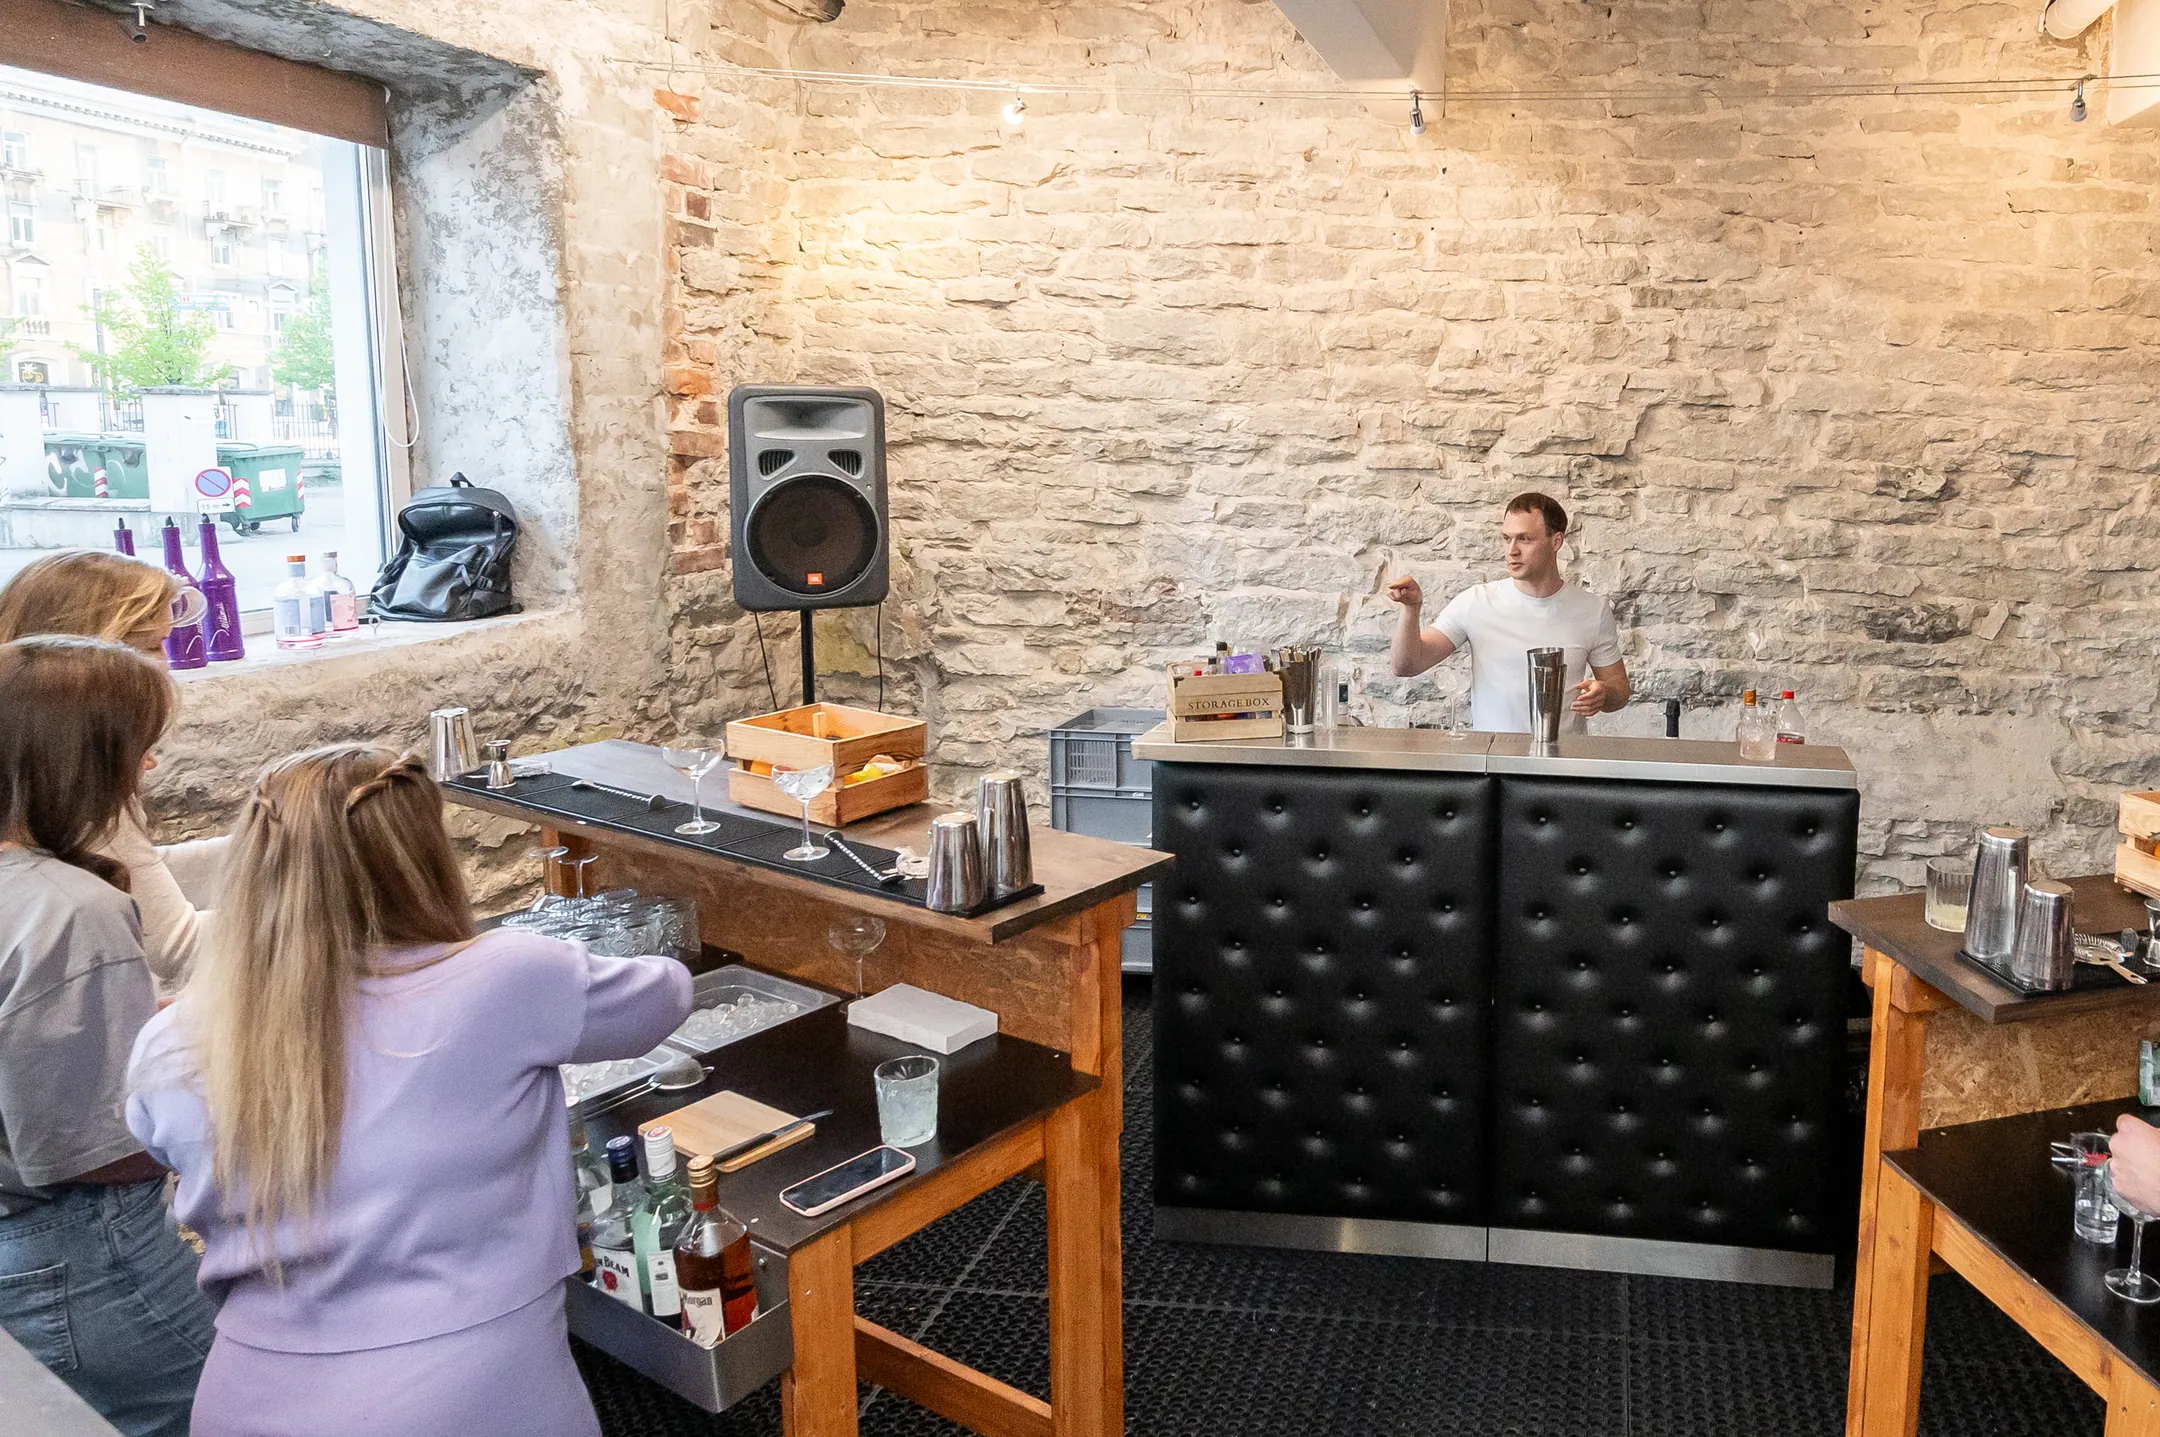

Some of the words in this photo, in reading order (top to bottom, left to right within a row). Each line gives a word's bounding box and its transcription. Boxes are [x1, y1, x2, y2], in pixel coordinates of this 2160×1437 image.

[1188, 699, 1243, 710] STORAGE
[1245, 697, 1270, 708] BOX
[603, 1255, 630, 1278] BEAM
